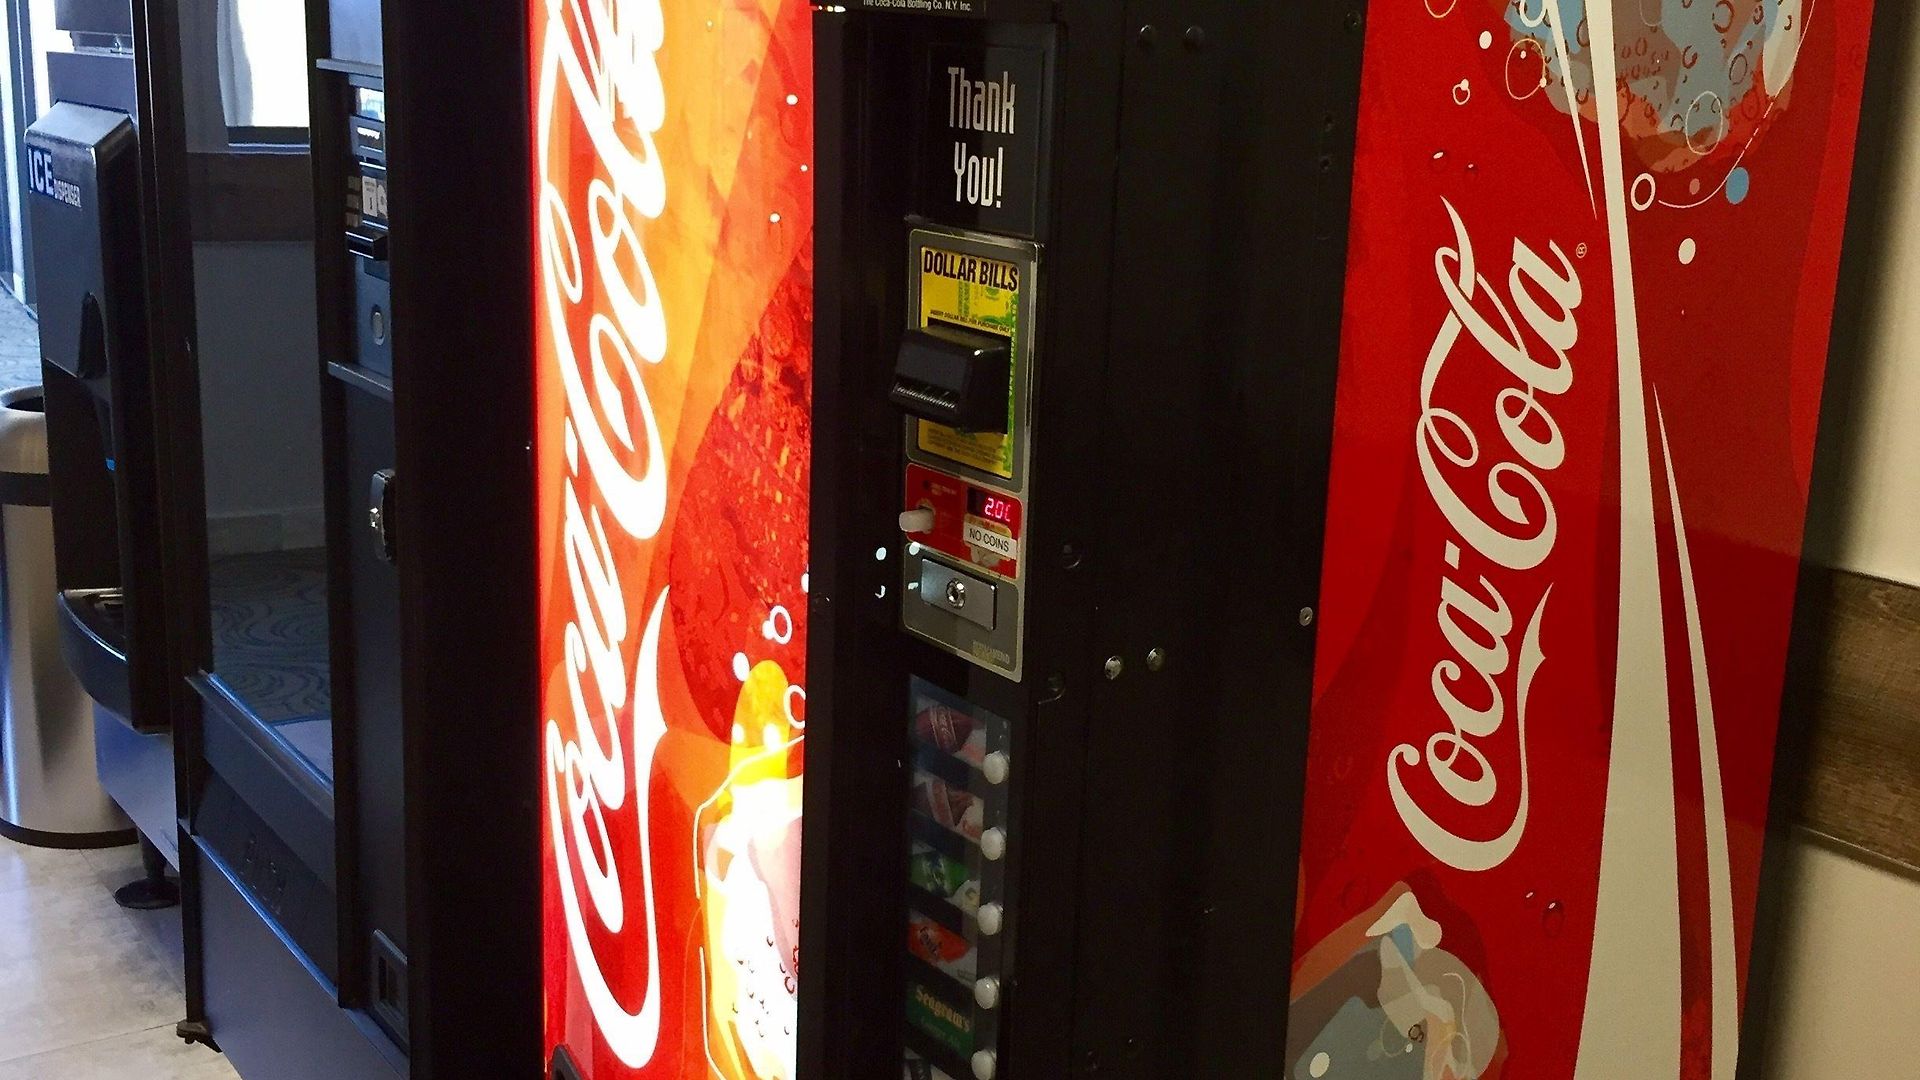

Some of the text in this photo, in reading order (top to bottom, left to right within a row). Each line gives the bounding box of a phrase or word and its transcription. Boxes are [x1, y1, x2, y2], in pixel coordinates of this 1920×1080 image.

[875, 0, 906, 8] Coca-Cola
[907, 0, 932, 11] Bottling
[932, 0, 944, 10] Co.
[948, 67, 1015, 134] Thank
[28, 148, 54, 196] ICE
[53, 178, 82, 208] DISPENSER
[954, 141, 1003, 208] You!
[924, 250, 1018, 292] DOLLAR BILLS
[969, 528, 1010, 552] NO COINS
[1386, 195, 1584, 872] Coca-Cola
